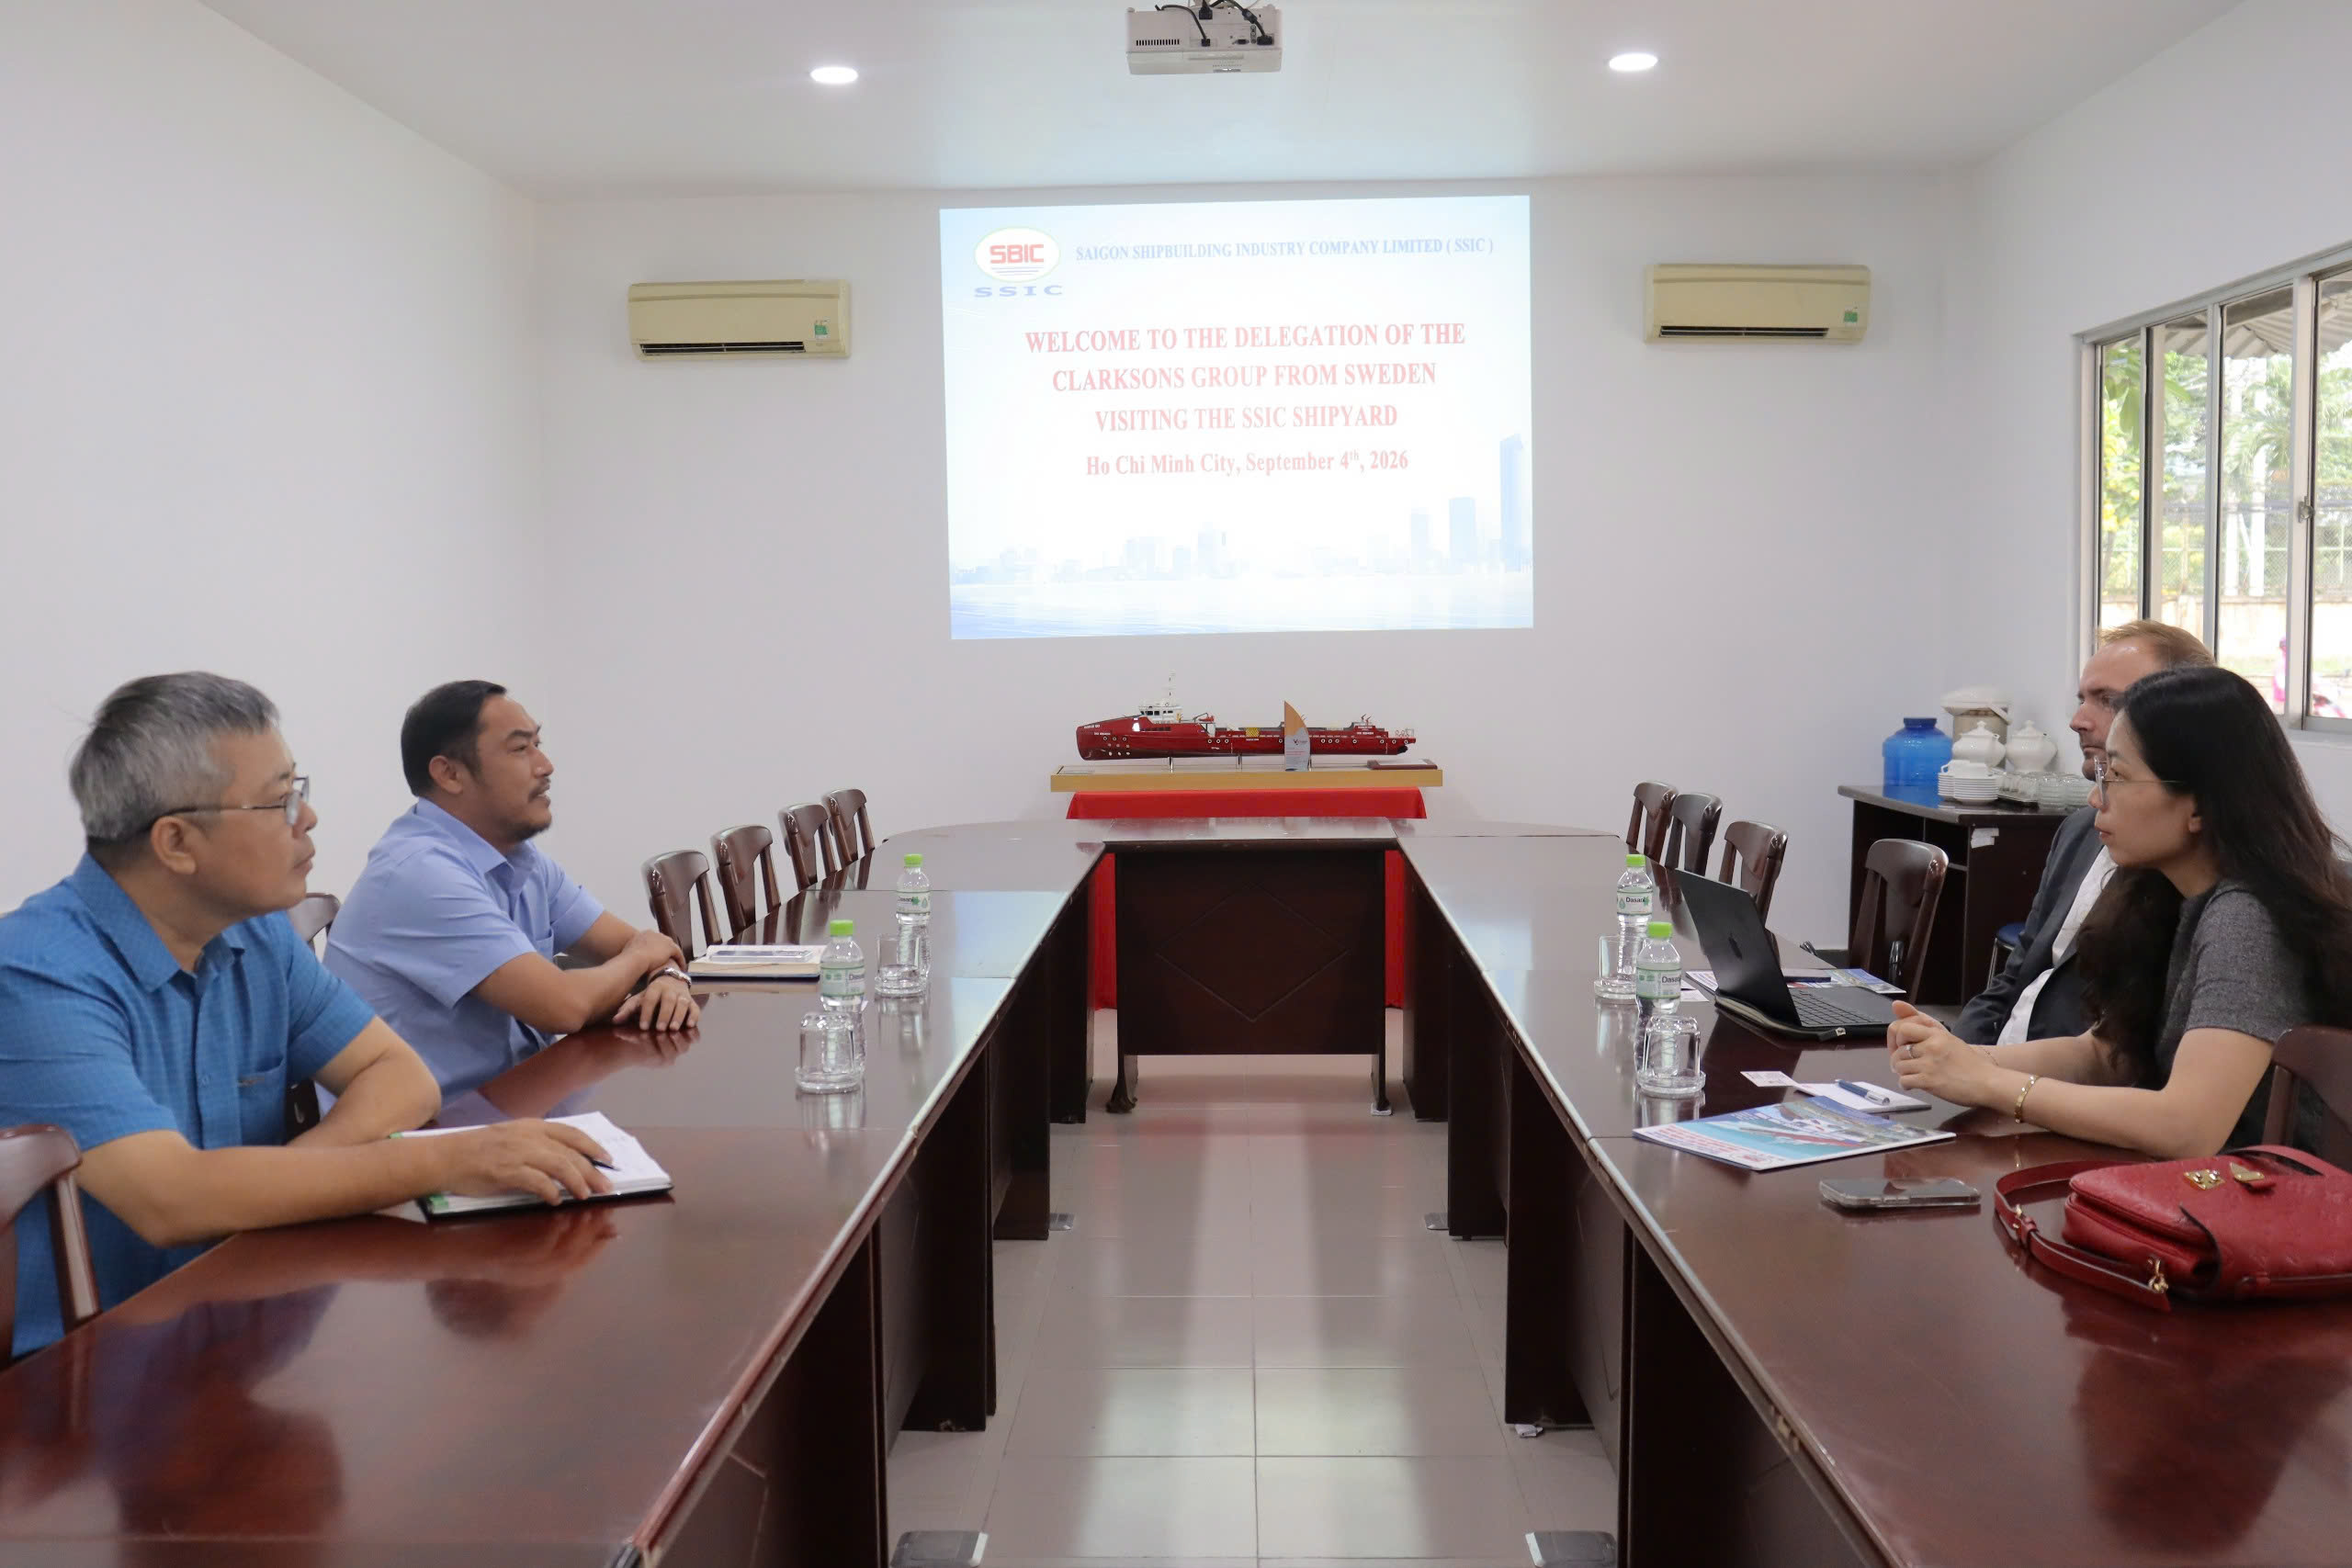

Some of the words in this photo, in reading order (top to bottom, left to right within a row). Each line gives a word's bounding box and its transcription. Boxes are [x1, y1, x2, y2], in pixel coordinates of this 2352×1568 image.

[989, 243, 1045, 265] SBIC
[1075, 244, 1129, 261] SAIGON
[1131, 243, 1232, 260] SHIPBUILDING
[1235, 242, 1306, 257] INDUSTRY
[1308, 240, 1379, 255] COMPANY
[1382, 238, 1443, 254] LIMITED
[974, 284, 1063, 299] SSIC
[1024, 329, 1141, 354] WELCOME
[1146, 328, 1178, 351] TO
[1182, 327, 1228, 349] THE
[1234, 323, 1378, 348] DELEGATION
[1385, 323, 1415, 346] OF
[1419, 322, 1466, 345] THE
[1052, 367, 1185, 392] CLARKSONS
[1191, 366, 1268, 389] GROUP
[1273, 364, 1339, 387] FROM
[1344, 362, 1436, 386] SWEDEN
[1094, 408, 1188, 432] VISITING
[1193, 407, 1236, 430] THE
[1241, 406, 1286, 429] SSIC
[1293, 404, 1397, 427] SHIPYARD
[1087, 456, 1111, 476] Ho
[1114, 455, 1146, 475] Chi
[1151, 454, 1195, 474] Minh
[1199, 453, 1241, 478] City,
[1246, 451, 1335, 477] September
[1340, 449, 1365, 473] 4th,
[1369, 449, 1409, 471] 2026
